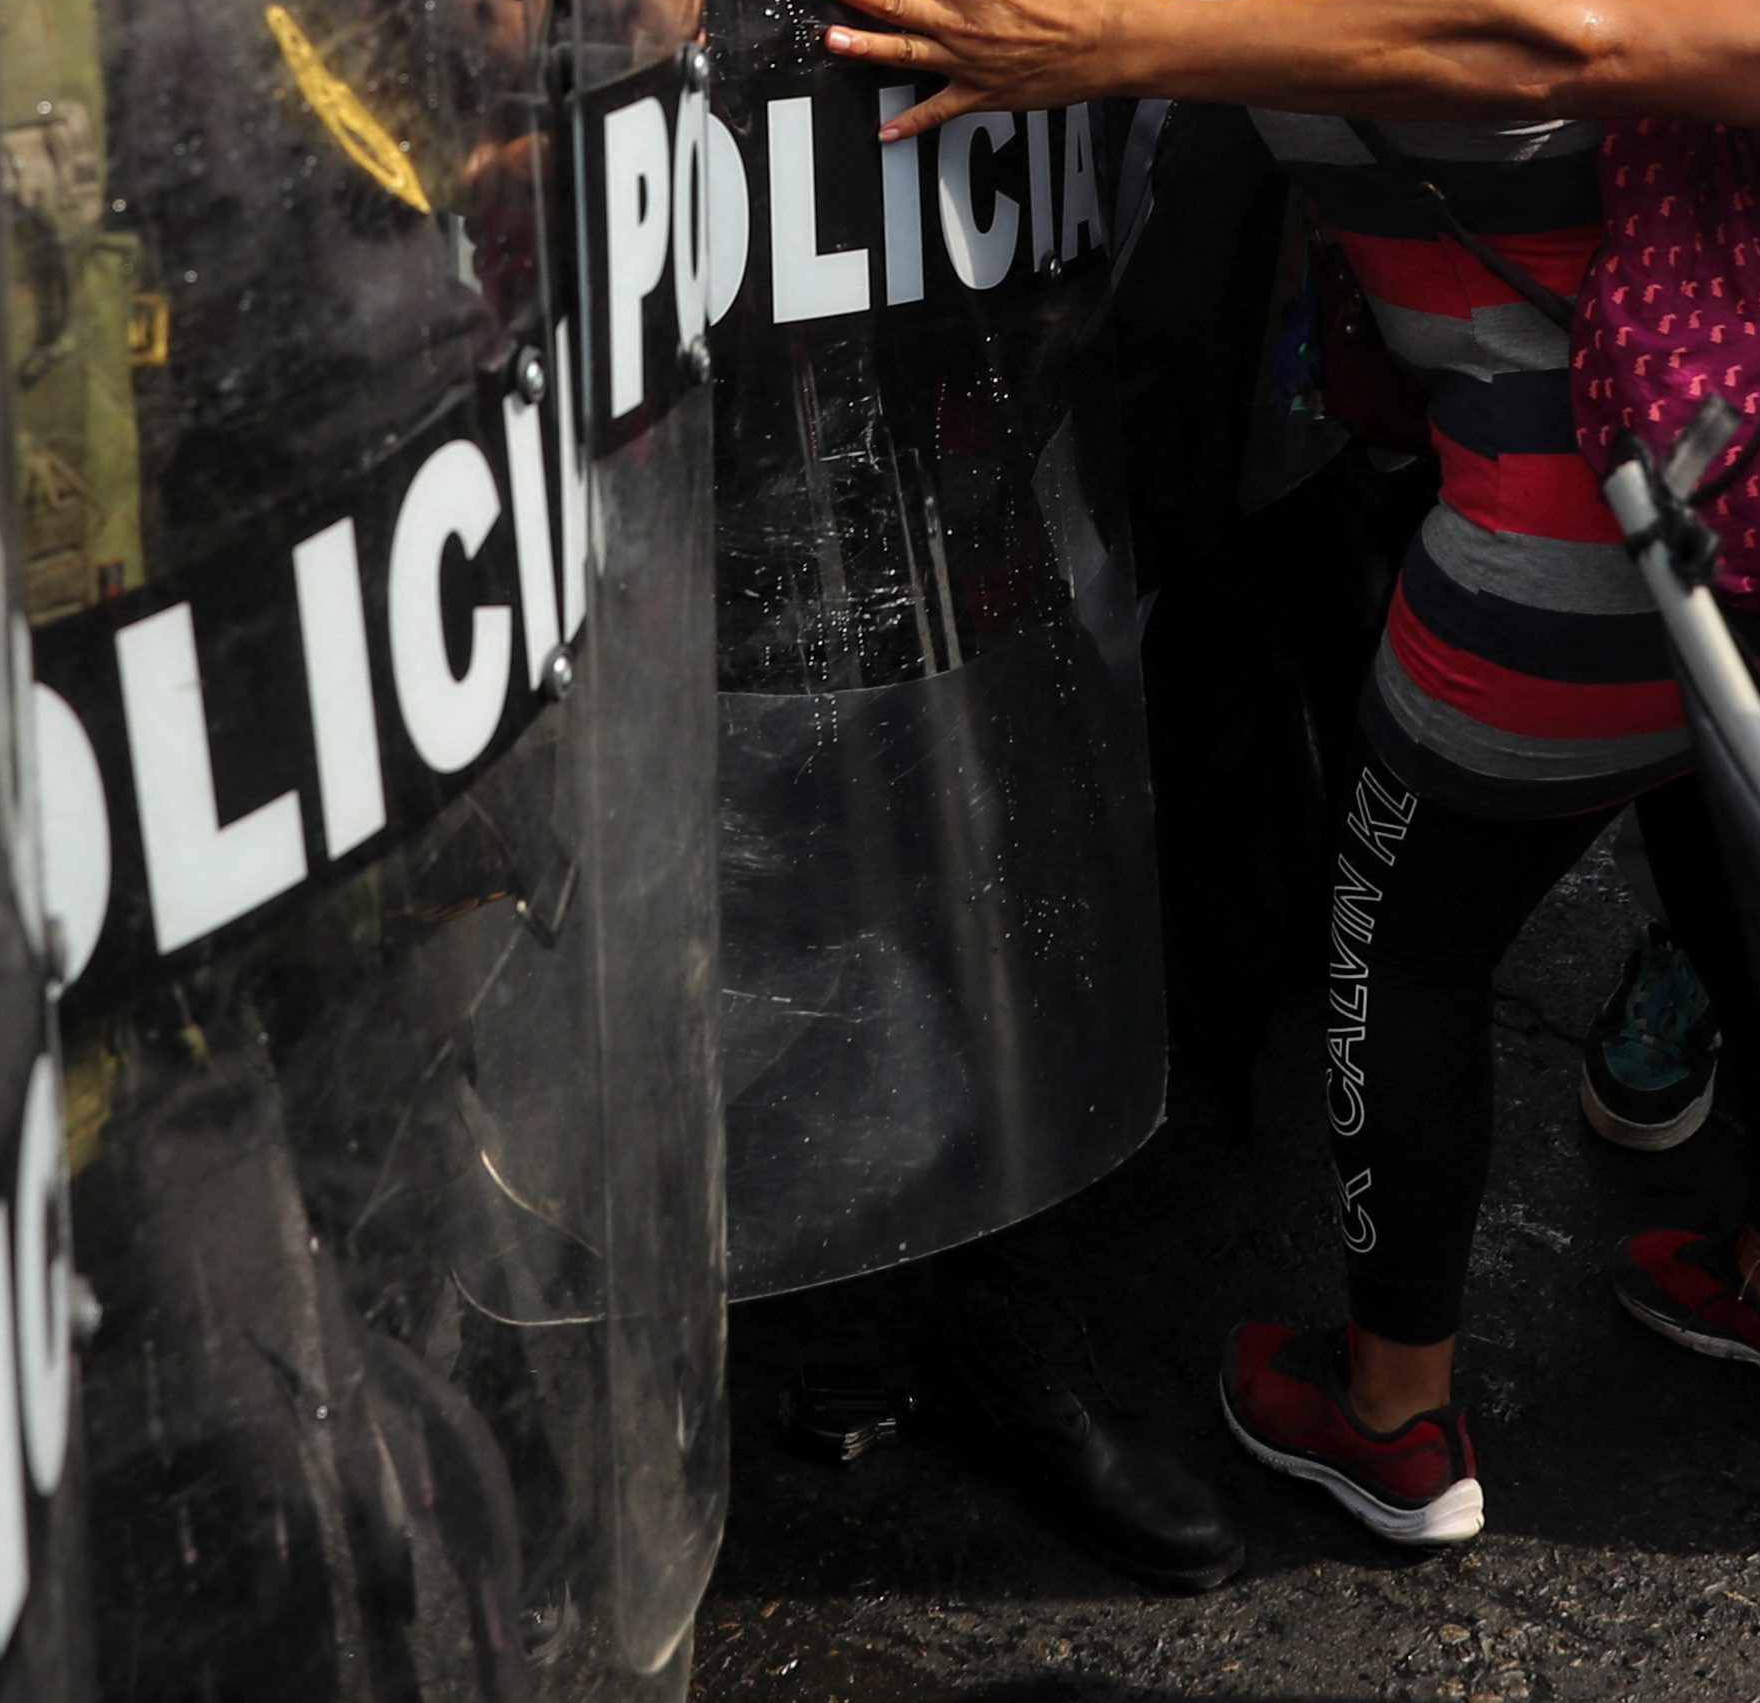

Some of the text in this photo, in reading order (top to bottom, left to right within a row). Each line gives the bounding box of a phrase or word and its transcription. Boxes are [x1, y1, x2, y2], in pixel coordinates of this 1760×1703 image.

[603, 84, 1106, 420] POLICIA
[1326, 766, 1419, 1254] CK CALVIN KL
